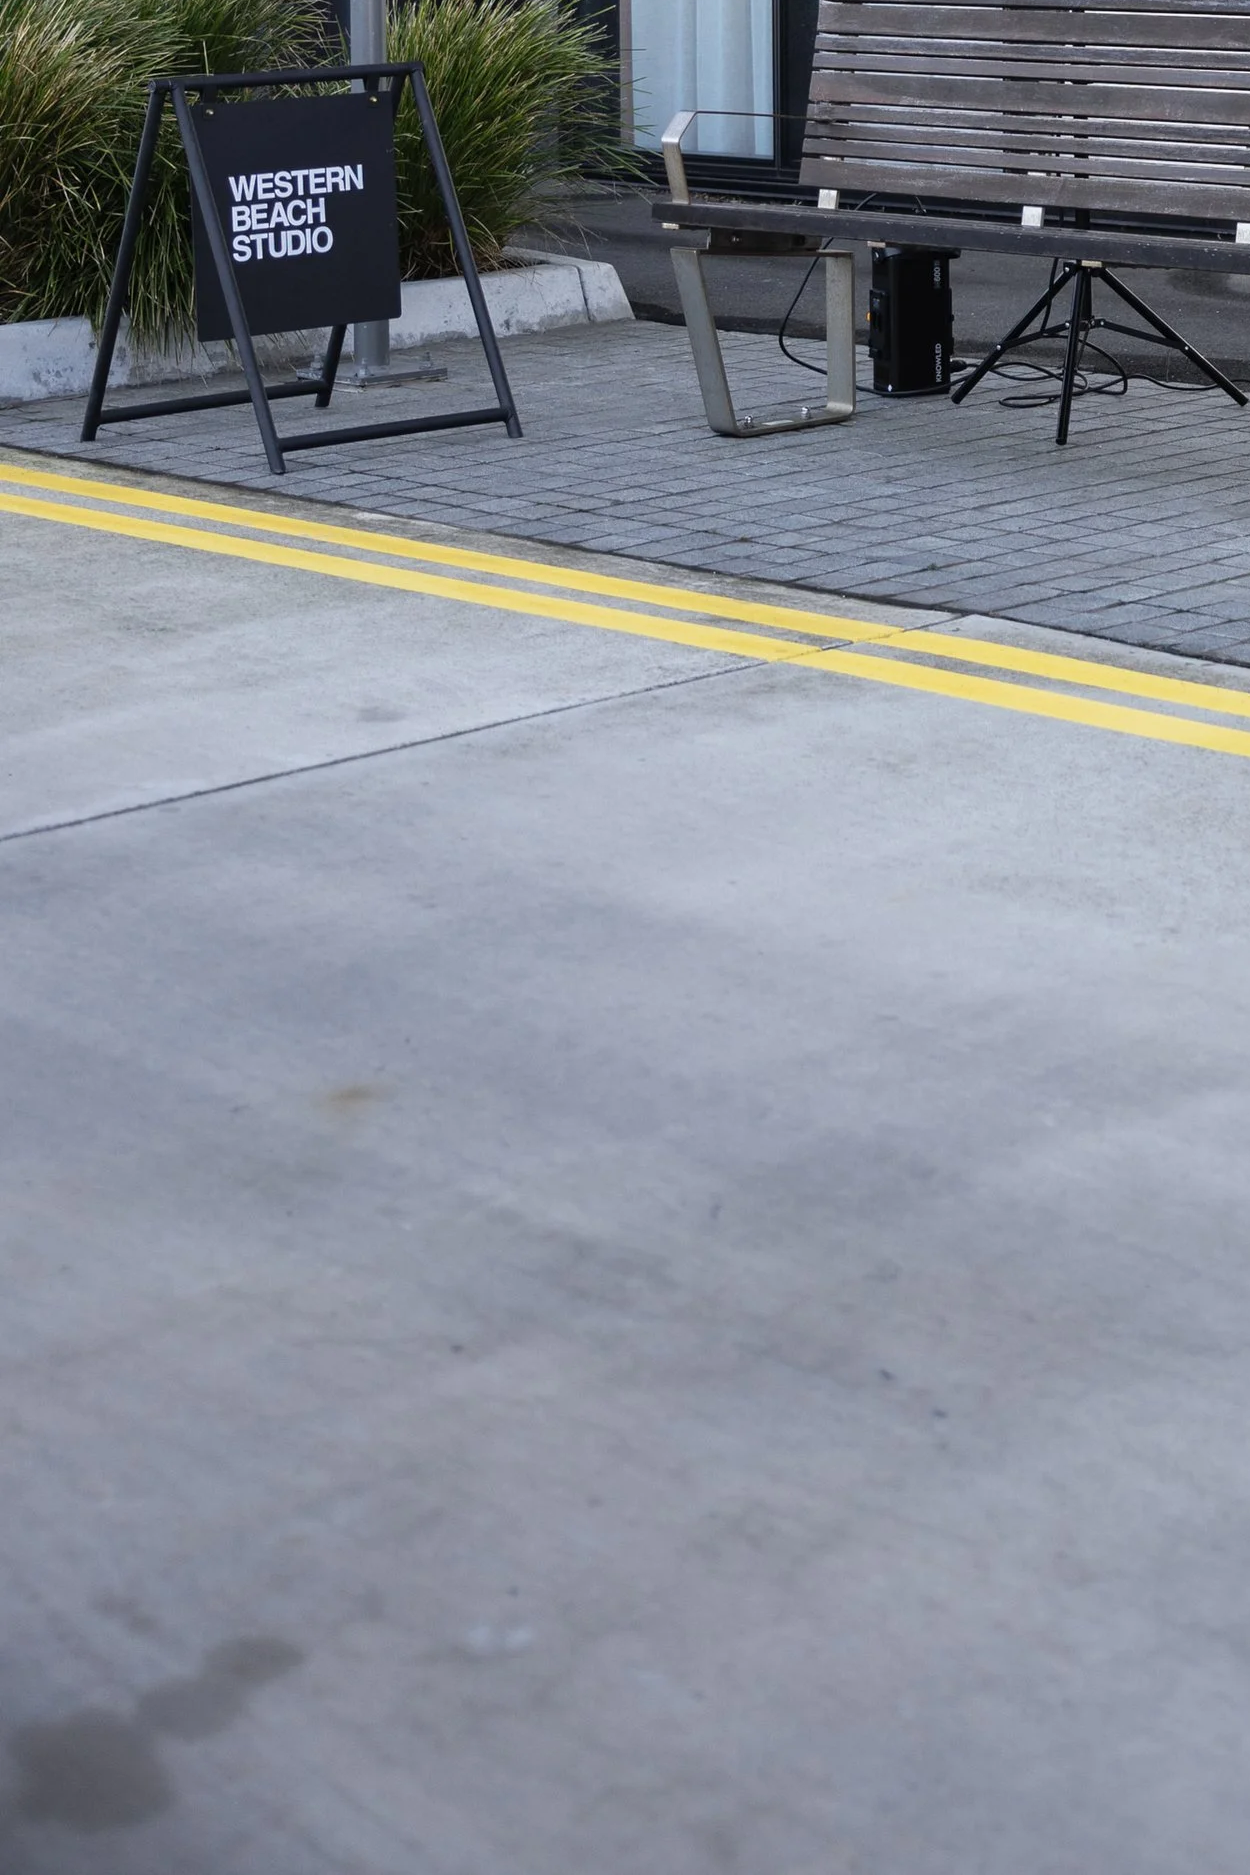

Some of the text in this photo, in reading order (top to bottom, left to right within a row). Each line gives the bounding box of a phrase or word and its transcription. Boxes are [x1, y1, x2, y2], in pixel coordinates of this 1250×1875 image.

[228, 164, 364, 202] WESTERN
[231, 197, 327, 232] BEACH
[232, 226, 334, 262] STUDIO
[935, 343, 943, 383] KNOWLED
